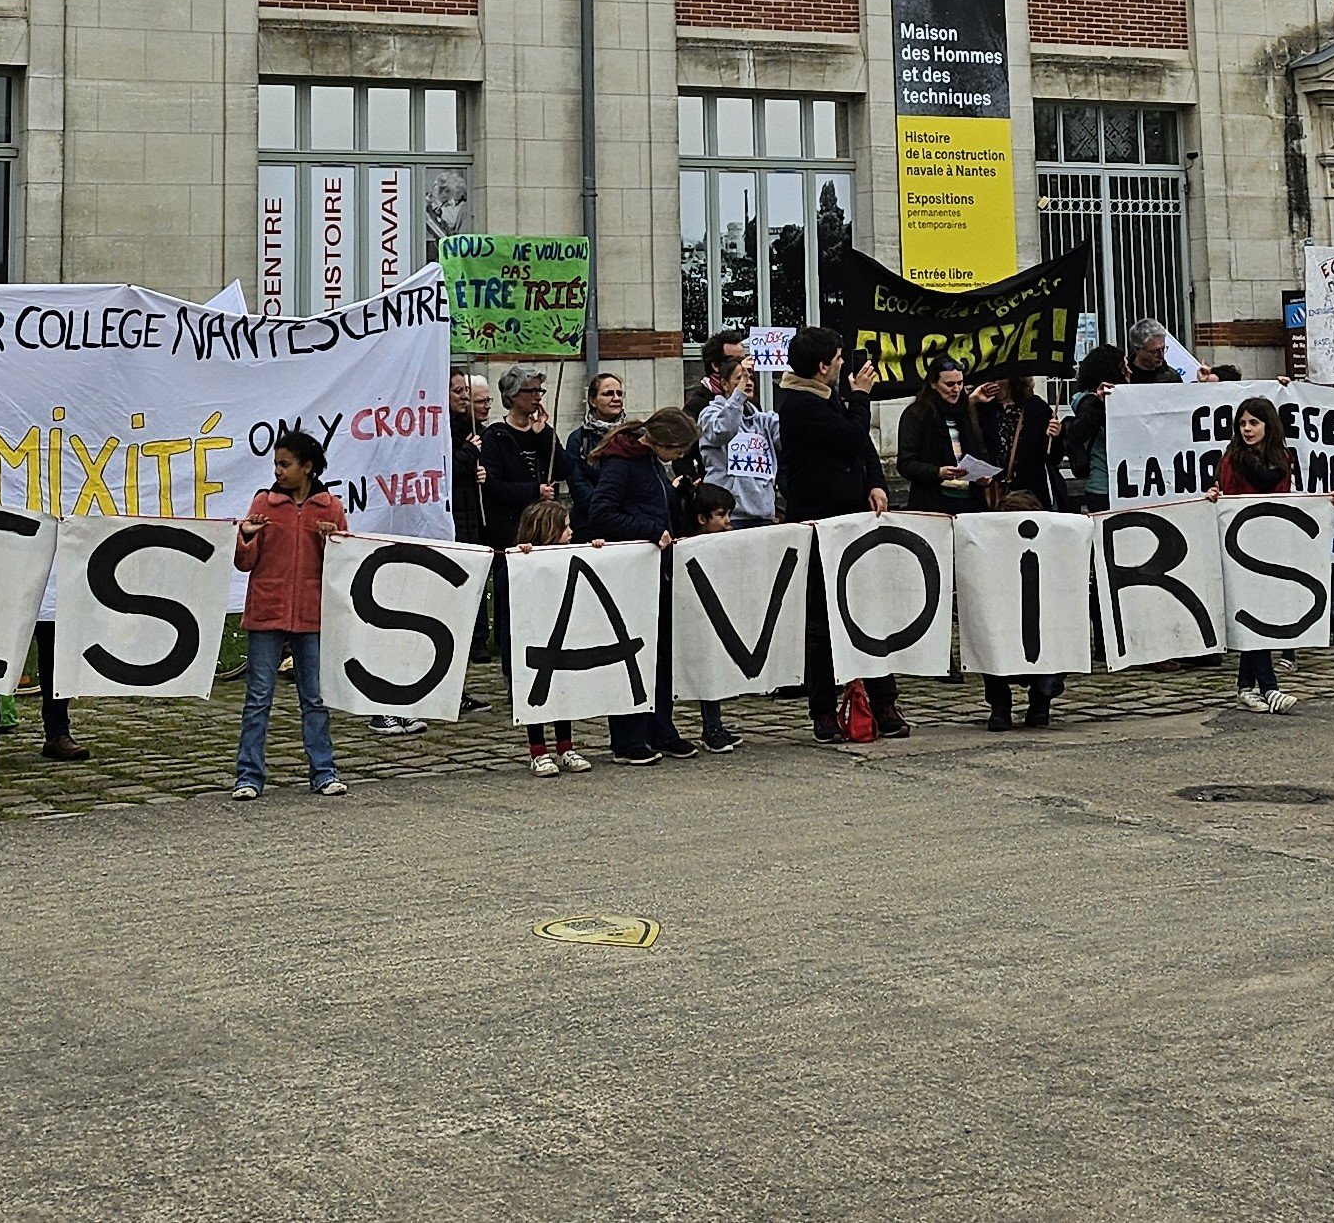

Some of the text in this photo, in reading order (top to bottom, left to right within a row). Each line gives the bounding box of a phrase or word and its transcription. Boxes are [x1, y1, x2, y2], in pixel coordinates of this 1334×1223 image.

[900, 22, 958, 42] Maison
[901, 43, 1004, 66] des Hommes
[902, 66, 951, 84] et des
[903, 87, 992, 109] techniques
[905, 130, 951, 145] Histoire
[905, 148, 1005, 163] de la construction
[906, 163, 997, 178] navale à Nantes
[907, 192, 975, 207] Expositions
[907, 208, 961, 219] permanentes
[907, 220, 967, 231] et temporaires
[323, 177, 342, 312] HISTOIRE
[442, 236, 589, 262] NOUS NE VOULONS
[263, 197, 282, 317] CENTRE
[500, 264, 531, 280] PAS
[909, 267, 974, 280] Entrée libre
[522, 275, 588, 311] TRIÉS
[874, 283, 930, 316] Ecole
[14, 305, 167, 351] COLLEGE
[171, 306, 341, 361] NANTES
[339, 280, 450, 340] CENTRE
[317, 412, 344, 452] Y
[350, 390, 443, 441] CROIT
[375, 469, 443, 507] VEUT
[1116, 456, 1165, 498] LA
[342, 501, 1327, 707] SAVOIRS
